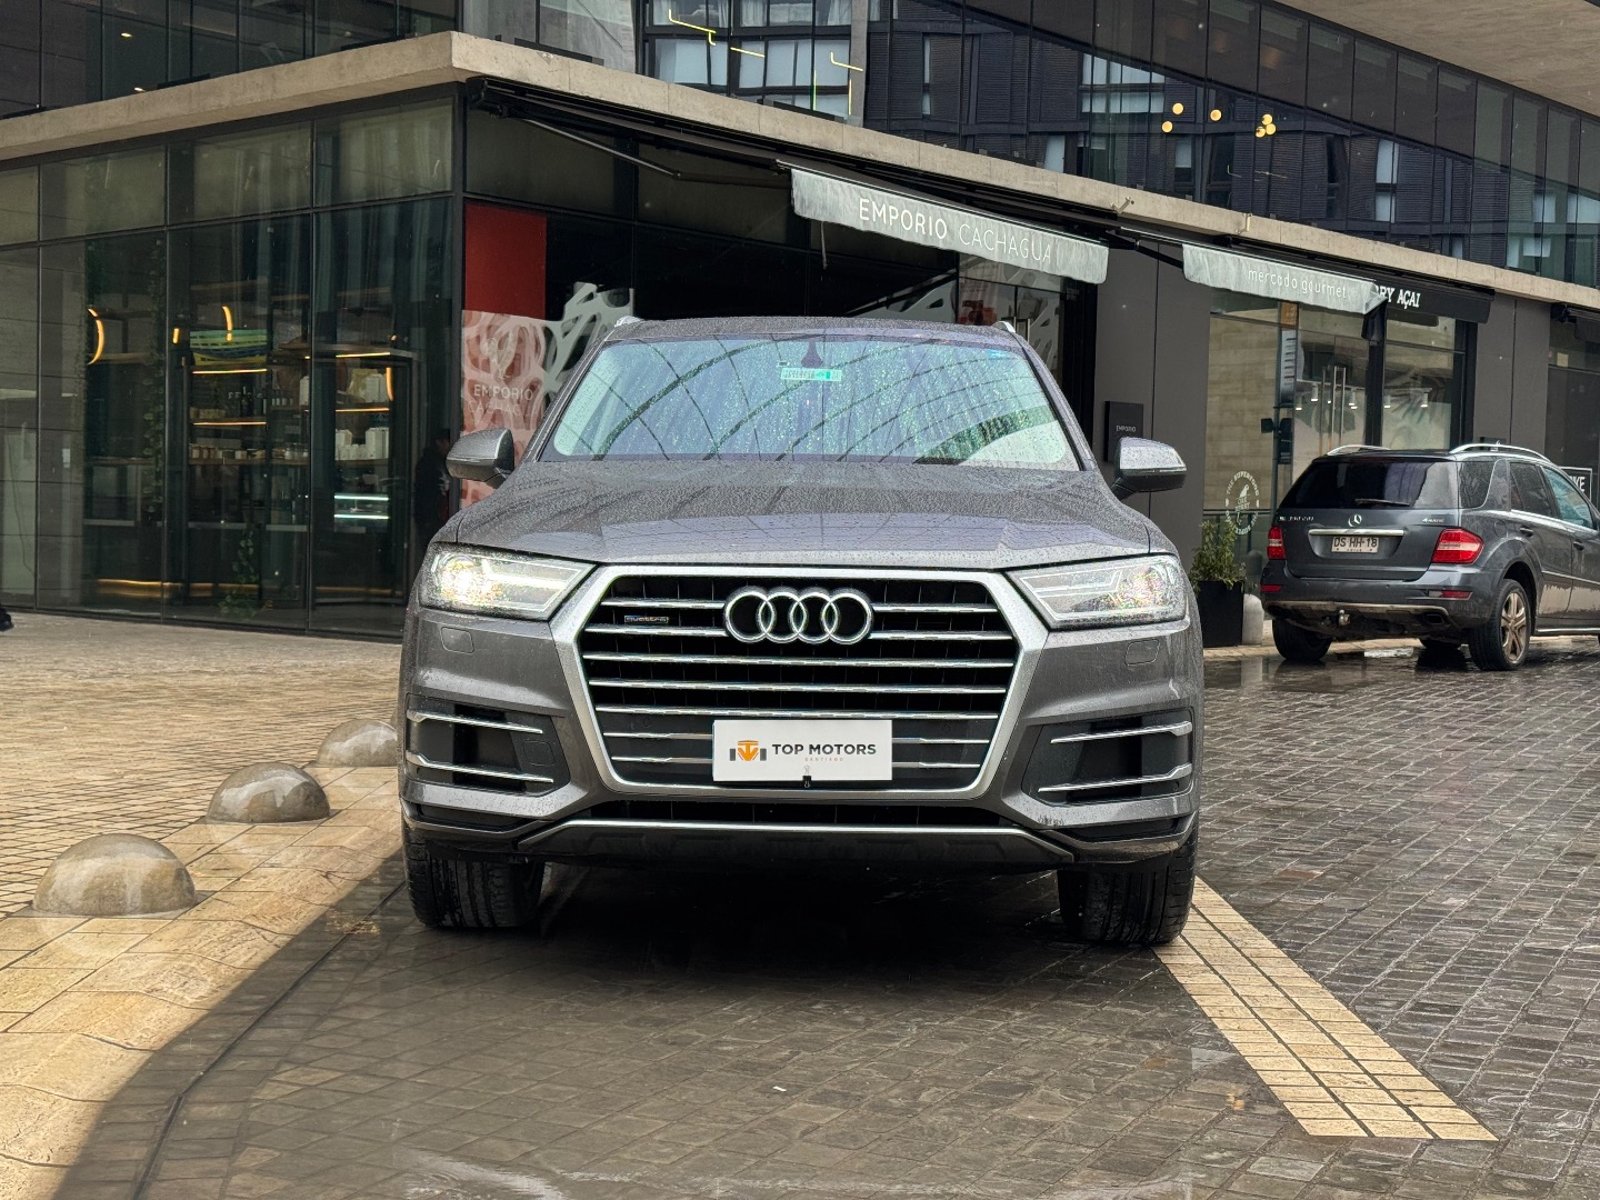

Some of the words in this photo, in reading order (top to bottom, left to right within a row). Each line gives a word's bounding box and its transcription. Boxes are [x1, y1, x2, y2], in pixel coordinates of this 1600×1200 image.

[859, 199, 948, 240] EMPORIO
[960, 223, 1051, 264] CACHAGUA
[1248, 269, 1298, 289] mercado
[1301, 280, 1347, 299] gourmet
[1397, 289, 1421, 310] AÇAI
[474, 384, 533, 400] EMPORIO
[772, 743, 804, 755] TOP
[809, 743, 877, 755] MOTORS
